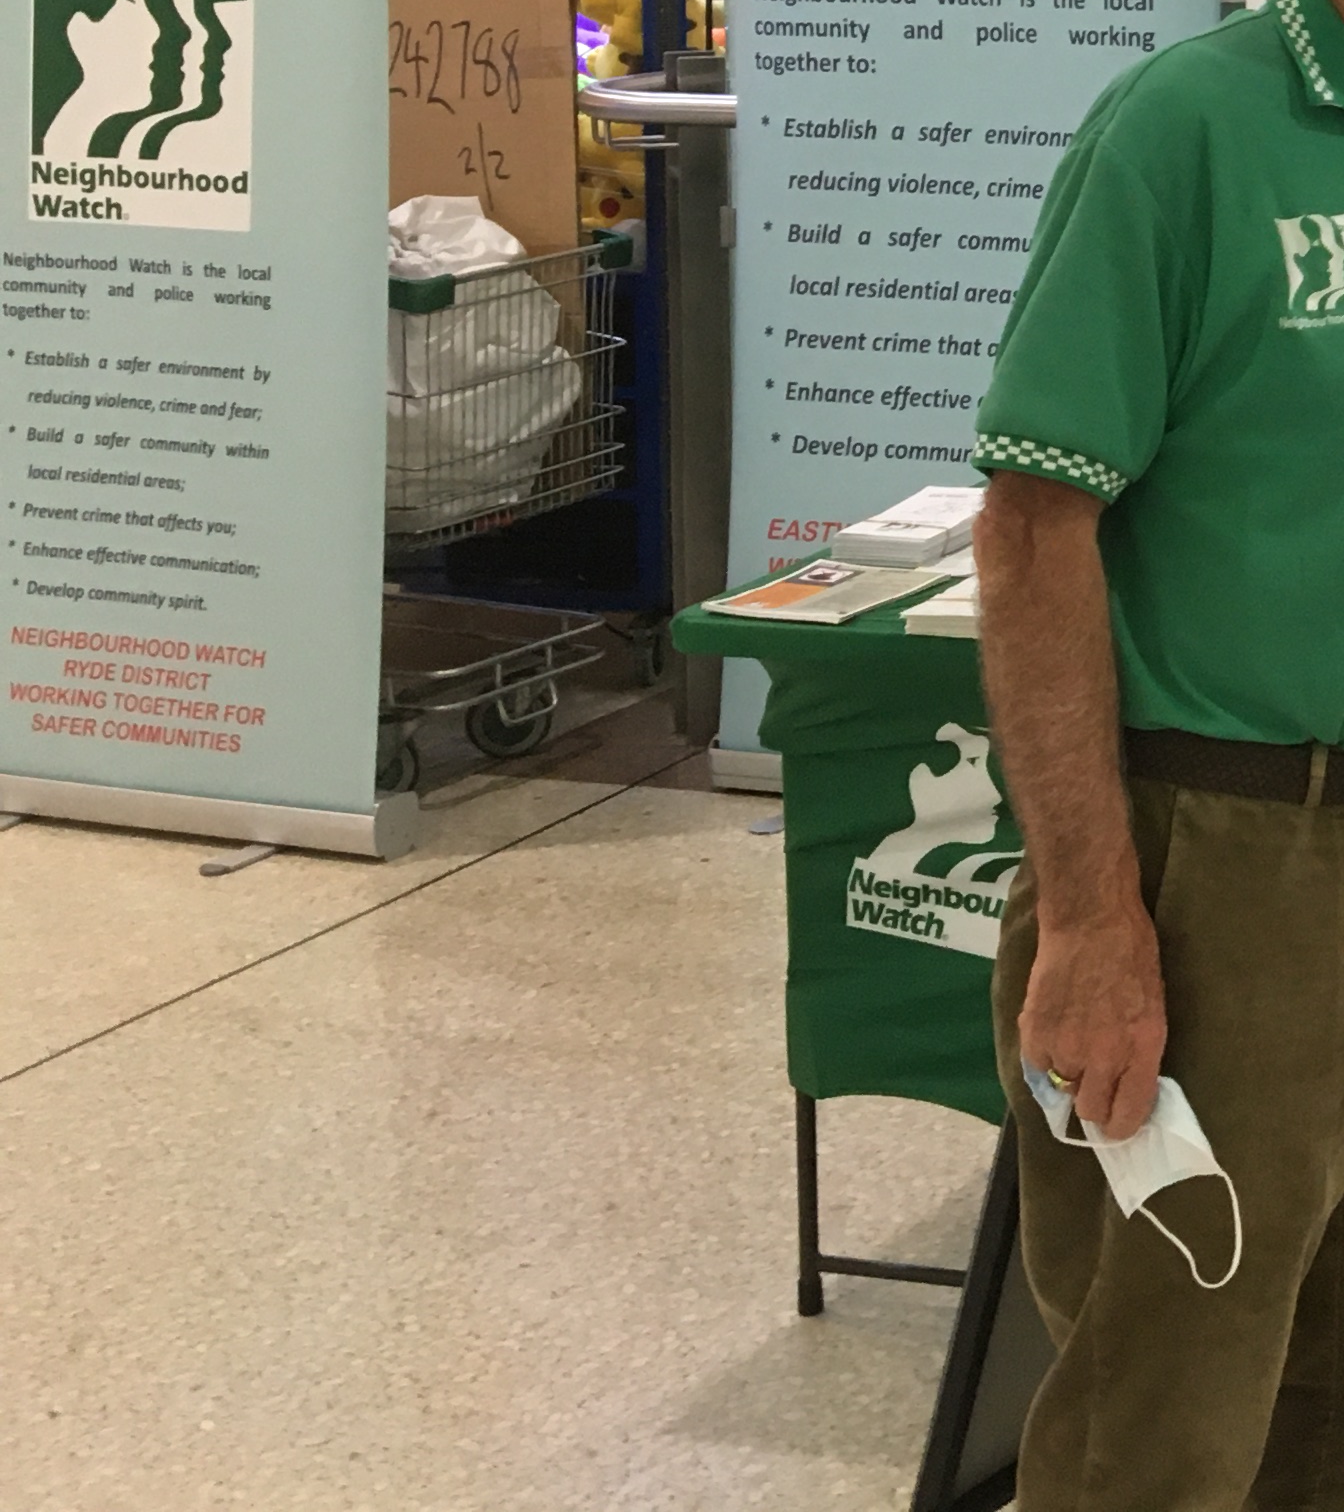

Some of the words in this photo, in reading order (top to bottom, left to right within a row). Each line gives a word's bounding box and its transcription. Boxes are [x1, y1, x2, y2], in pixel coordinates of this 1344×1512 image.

[754, 17, 870, 43] community
[903, 20, 943, 40] and
[976, 22, 1037, 46] police
[1068, 26, 1155, 52] working
[755, 51, 841, 75] together
[847, 54, 877, 74] to:
[784, 118, 877, 140] Establish
[891, 124, 904, 141] a
[918, 122, 971, 148] safer
[31, 161, 249, 194] Neighbourhood
[458, 122, 511, 211] 2/2
[789, 172, 880, 197] reducing
[888, 174, 980, 200] violence,
[987, 178, 1044, 200] crime
[33, 193, 122, 220] Watch
[787, 223, 841, 245] Build
[857, 230, 871, 246] a
[888, 228, 941, 252] safer
[3, 252, 117, 271] Neighbourhood
[130, 258, 171, 274] Watch
[183, 262, 193, 276] is
[204, 263, 226, 278] the
[238, 264, 271, 281] local
[2, 280, 86, 297] community
[108, 283, 134, 297] and
[155, 286, 194, 303] police
[214, 291, 271, 310] working
[789, 275, 839, 297] local
[846, 278, 959, 301] residential
[2, 303, 65, 320] together
[70, 307, 90, 320] to:
[785, 329, 866, 352] Prevent
[872, 333, 930, 356] crime
[938, 334, 981, 358] that
[25, 351, 89, 367] Establish
[98, 359, 107, 369] a
[116, 356, 150, 374] safer
[159, 361, 244, 379] environment
[254, 366, 271, 384] by
[28, 390, 90, 409] reducing
[96, 393, 155, 413] violence,
[160, 399, 196, 414] crime
[201, 402, 225, 416] and
[228, 403, 262, 421] fear;
[785, 381, 874, 405] Enhance
[880, 384, 971, 411] effective
[27, 427, 64, 443] Build
[75, 434, 83, 444] a
[94, 433, 130, 450] safer
[140, 437, 215, 457] community
[225, 443, 269, 459] within
[792, 435, 878, 460] Develop
[28, 464, 62, 480] local
[66, 468, 140, 485] residential
[144, 475, 185, 492] areas;
[23, 503, 78, 521] Prevent
[82, 508, 121, 523] crime
[126, 511, 154, 527] that
[158, 513, 202, 532] affects
[207, 521, 236, 536] you;
[23, 542, 82, 559] Enhance
[87, 546, 146, 565] effective
[150, 553, 260, 579] communication;
[27, 580, 84, 601] Develop
[88, 587, 165, 608] community
[169, 595, 207, 611] spirit.
[11, 626, 189, 660] NEIGHBOURHOOD
[196, 644, 266, 668] WATCH
[64, 659, 116, 681] RYDE
[122, 664, 211, 691] DISTRICT
[10, 682, 107, 709] WORKING
[114, 692, 219, 721] TOGETHER
[224, 705, 265, 726] FOR
[32, 713, 96, 736] SAFER
[102, 720, 241, 753] COMMUNITIES
[850, 868, 1007, 919] Neighbou
[852, 898, 944, 939] Watch
